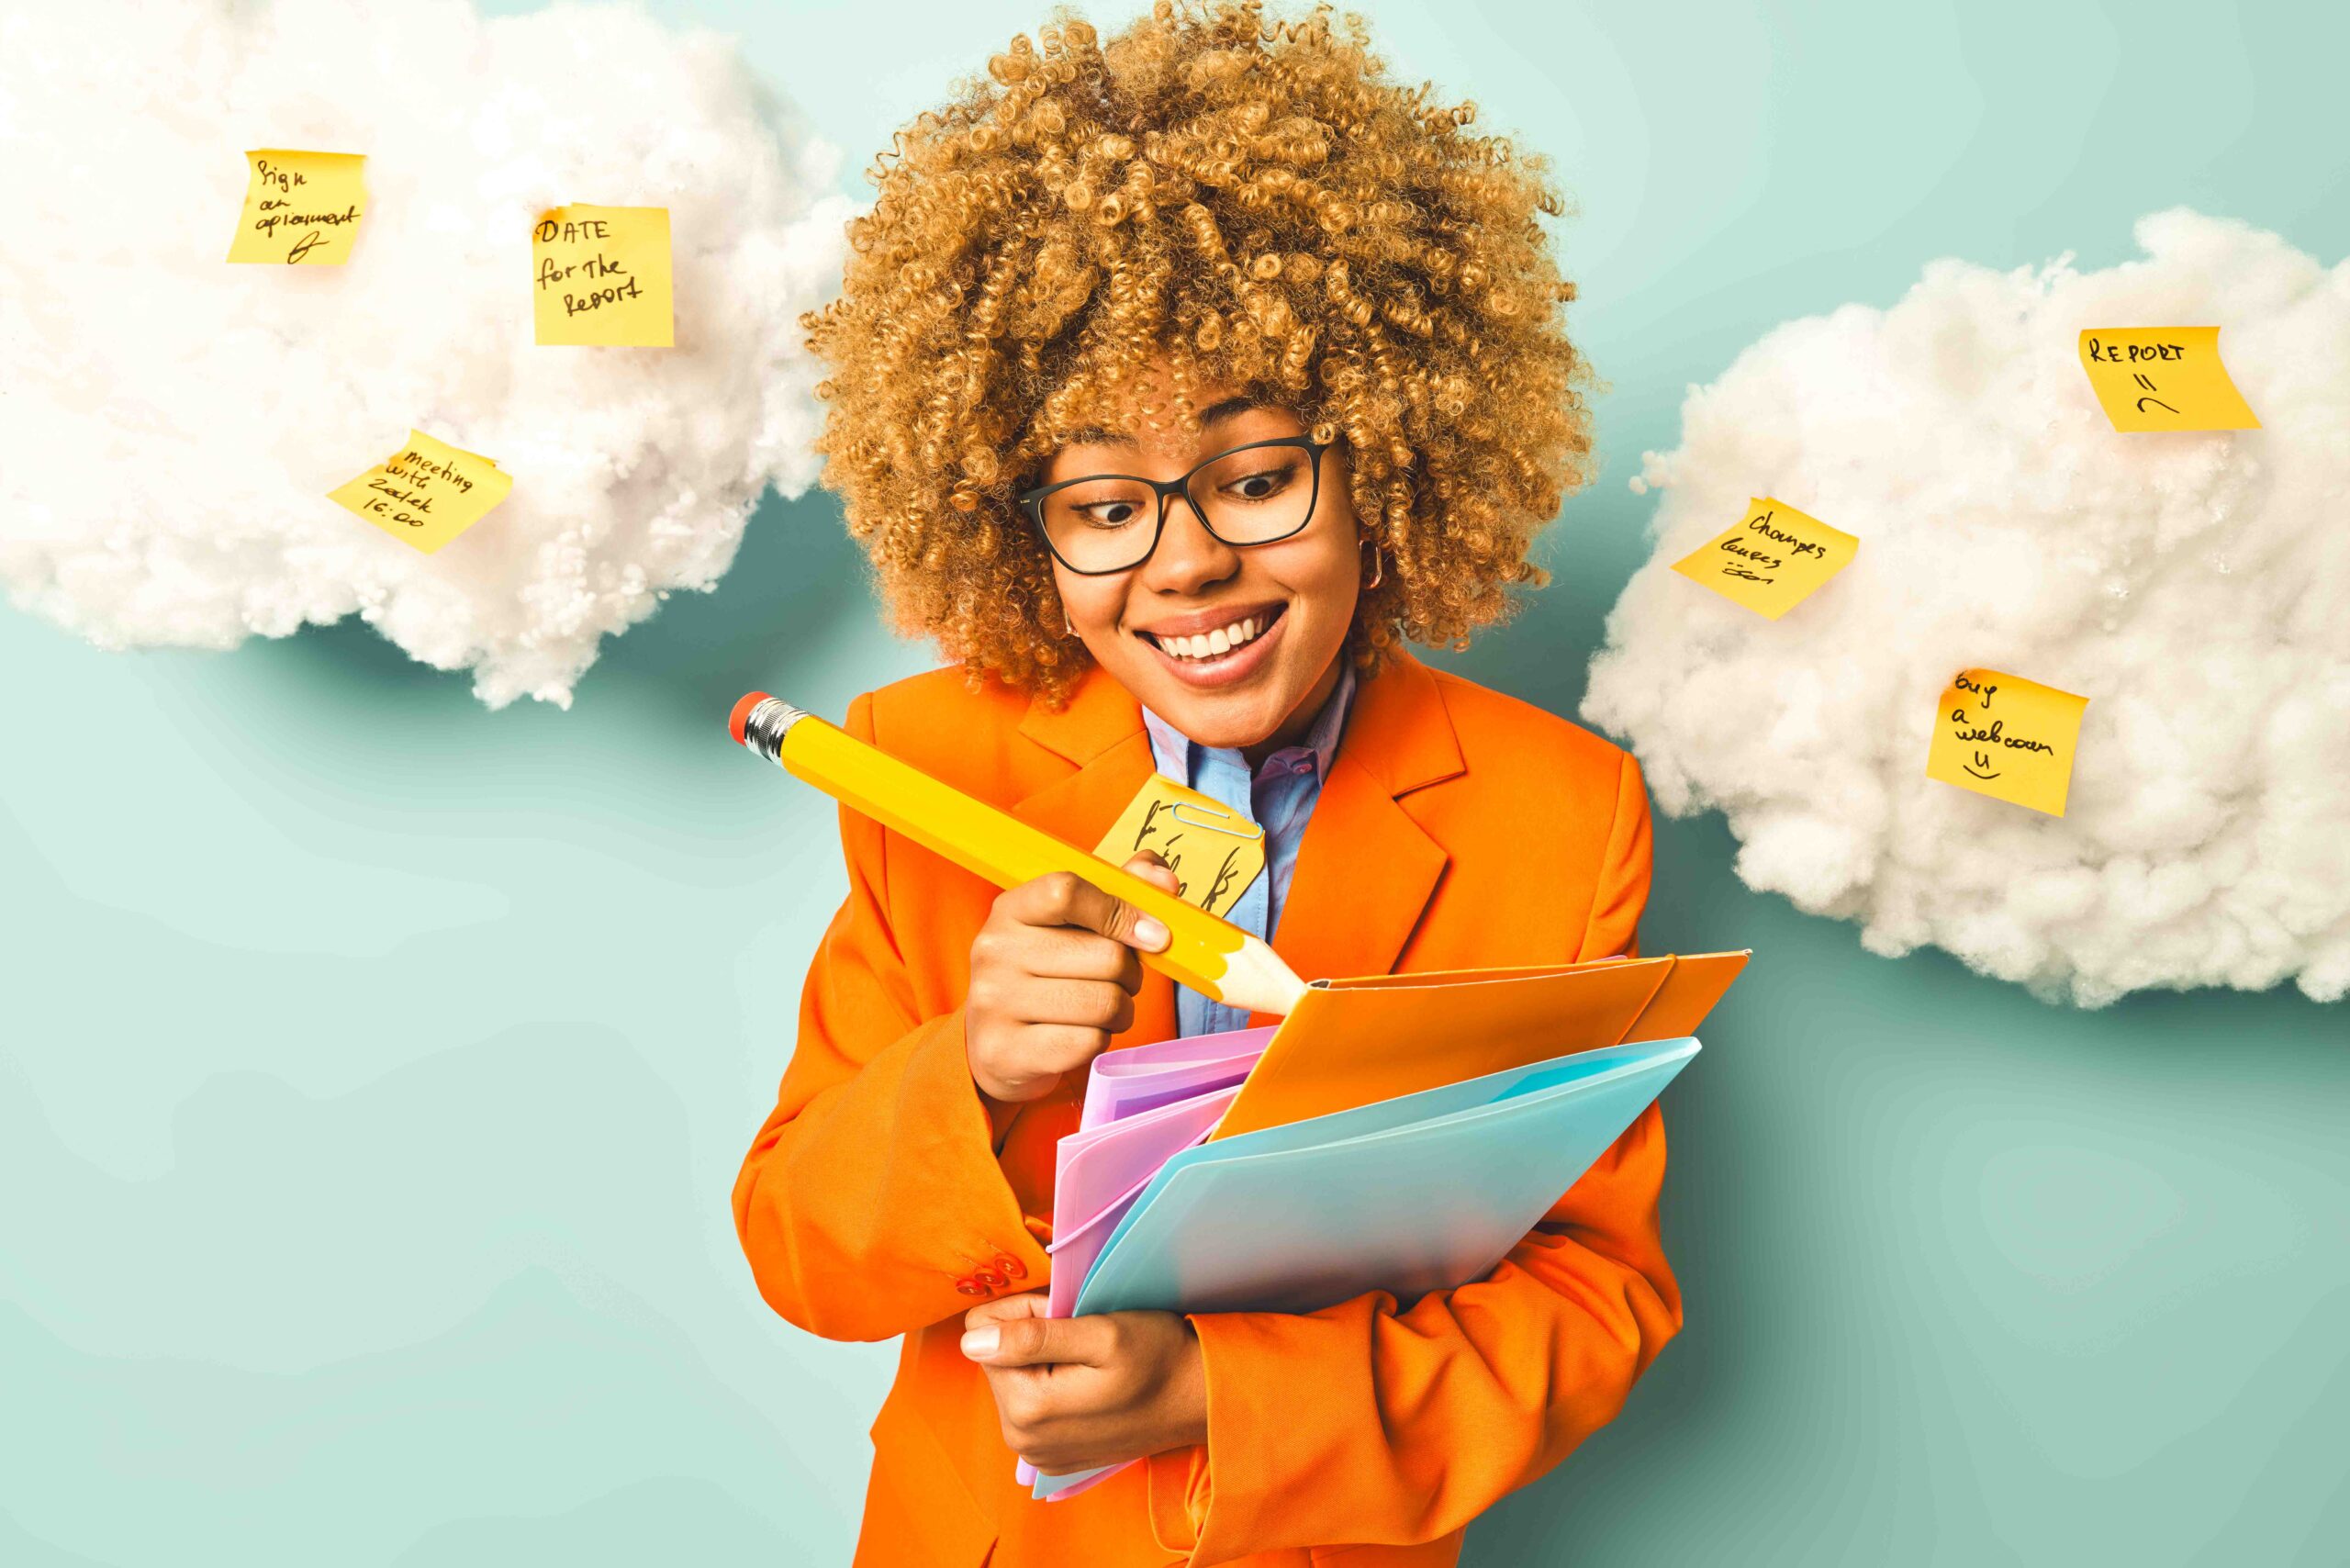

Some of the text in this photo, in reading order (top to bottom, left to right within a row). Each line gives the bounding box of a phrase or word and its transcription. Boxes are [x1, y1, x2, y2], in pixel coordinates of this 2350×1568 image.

[535, 219, 610, 244] DATE
[537, 257, 576, 290] for
[2089, 338, 2185, 364] REPORT
[386, 464, 431, 490] with
[364, 498, 424, 527] 16:00
[1952, 709, 1970, 724] a
